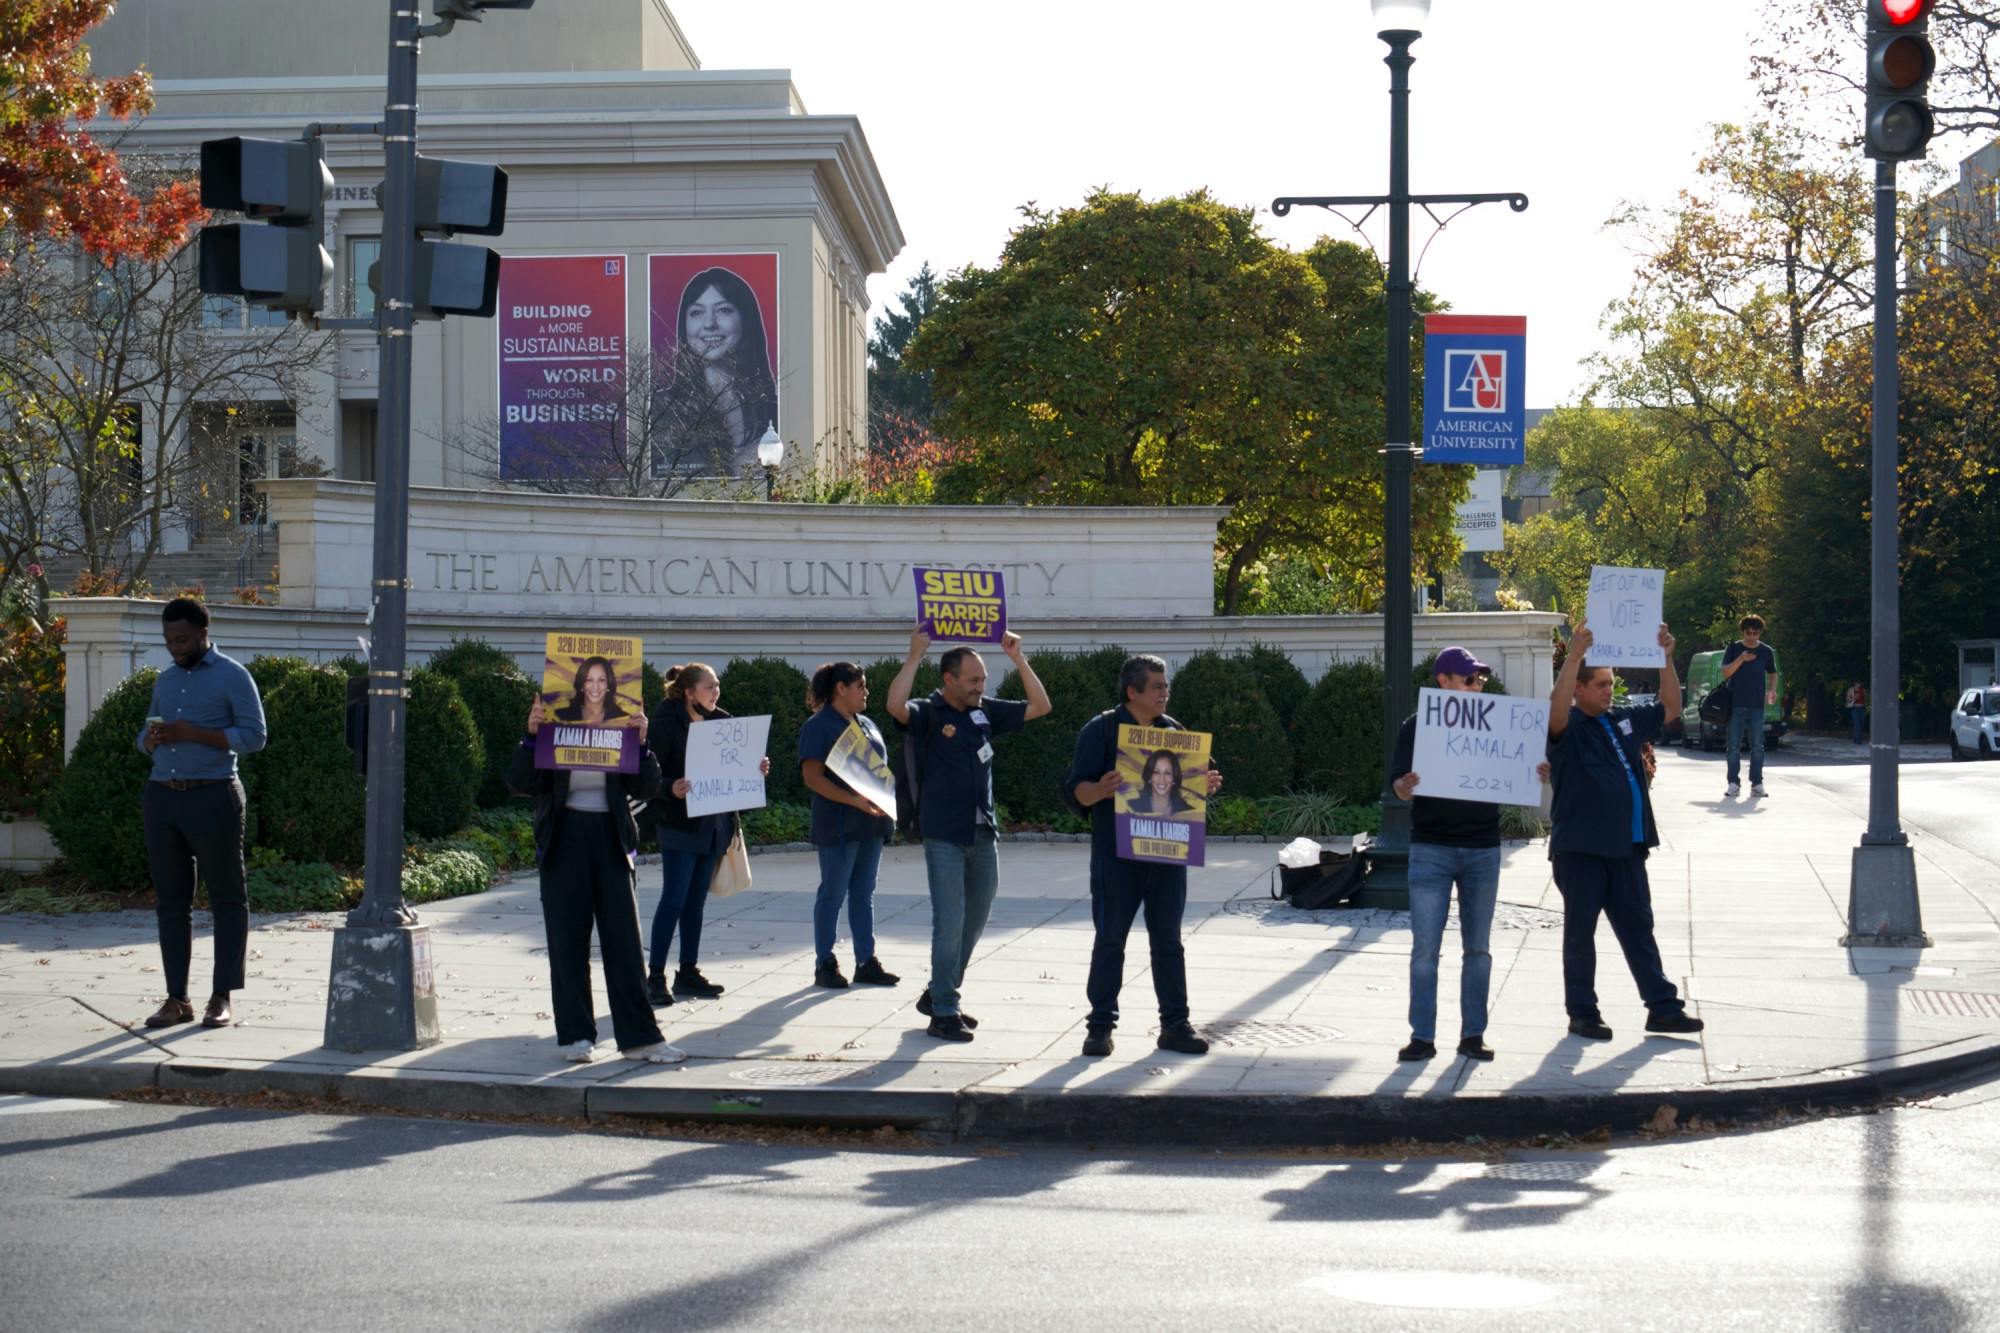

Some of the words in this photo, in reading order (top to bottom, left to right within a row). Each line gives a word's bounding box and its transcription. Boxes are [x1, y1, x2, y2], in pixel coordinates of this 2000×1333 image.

[512, 305, 592, 319] BUILDING
[548, 322, 583, 333] MORE
[504, 336, 620, 353] SUSTAINABLE
[544, 368, 616, 383] WORLD
[526, 389, 585, 400] THROUGH
[506, 402, 619, 423] BUSINESS
[1435, 419, 1513, 433] AMERICAN
[1431, 435, 1518, 450] UNIVERSITY
[426, 552, 498, 591] THE
[522, 554, 759, 596] AMERICAN
[783, 561, 1065, 597] UNIVTY
[923, 570, 995, 597] SEIU
[924, 602, 1000, 622] HARRIS
[1609, 599, 1645, 629] VOTE
[933, 620, 987, 638] WALZ
[596, 638, 633, 656] SUPPORTS
[1426, 695, 1495, 732] HONK
[1510, 704, 1546, 736] FOR
[554, 727, 590, 746] KAMALA
[1164, 733, 1200, 751] SUPPORTS
[1446, 732, 1525, 760] KAMALA
[721, 748, 743, 766] FOR
[1458, 775, 1513, 793] 2024
[1130, 818, 1161, 838] KAMALA
